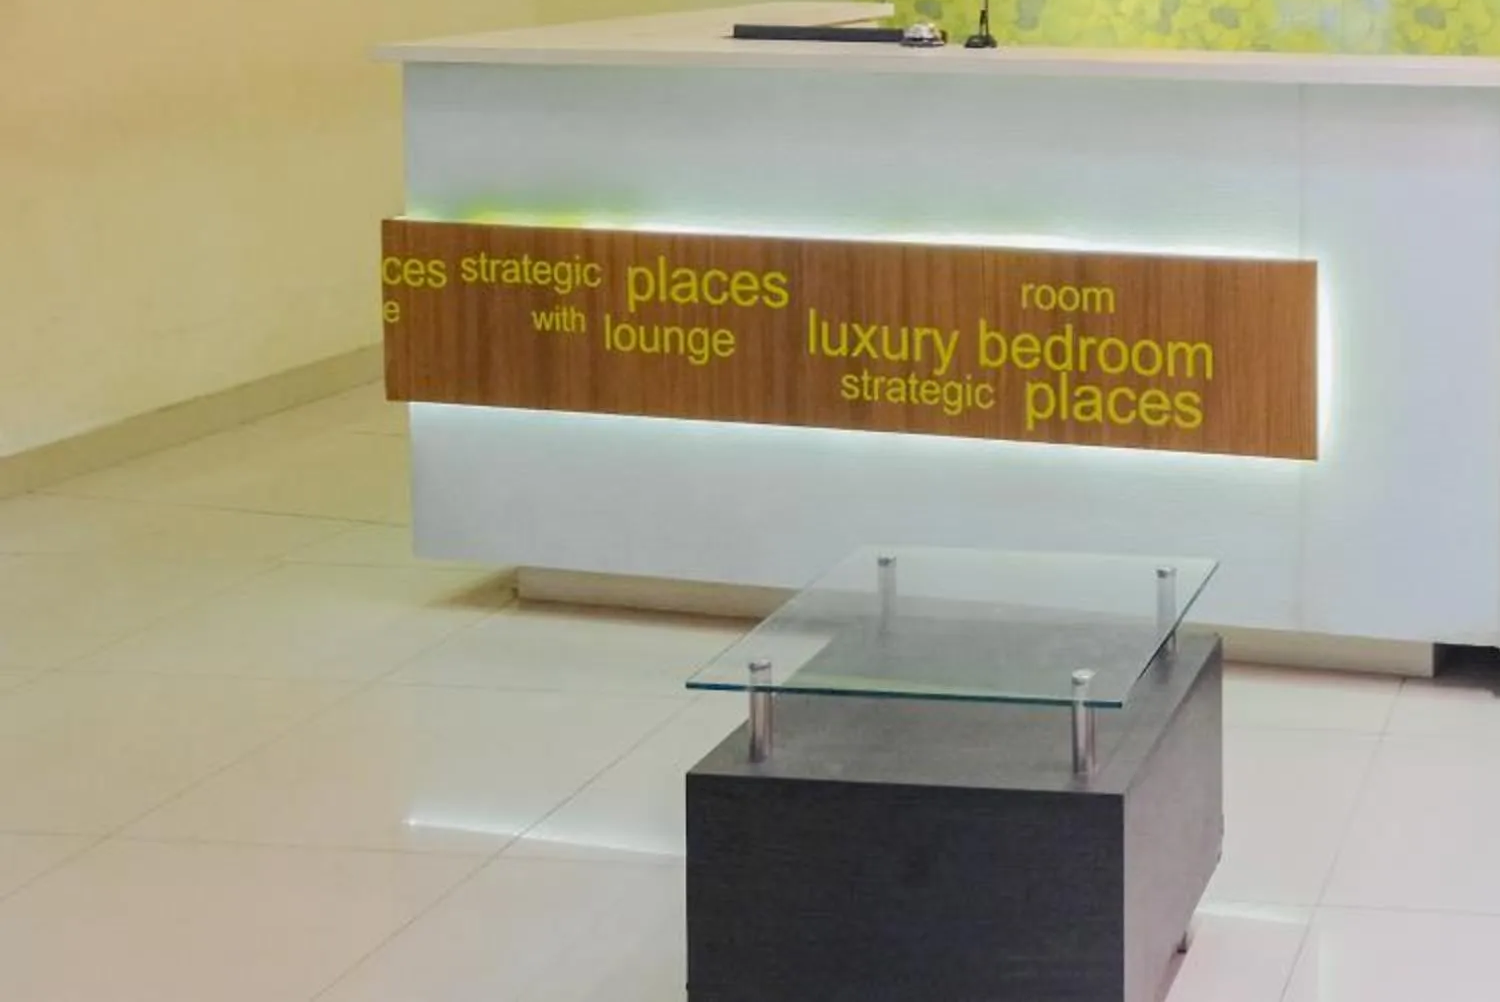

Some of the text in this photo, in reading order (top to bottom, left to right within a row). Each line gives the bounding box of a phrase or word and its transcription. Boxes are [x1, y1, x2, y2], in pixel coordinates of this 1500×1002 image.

[460, 251, 602, 296] strategic
[627, 255, 791, 313] places
[1020, 281, 1116, 314] room
[531, 305, 587, 334] with
[603, 313, 736, 366] lounge
[807, 307, 1214, 381] luxury bedroom
[840, 368, 1205, 431] strategic places
